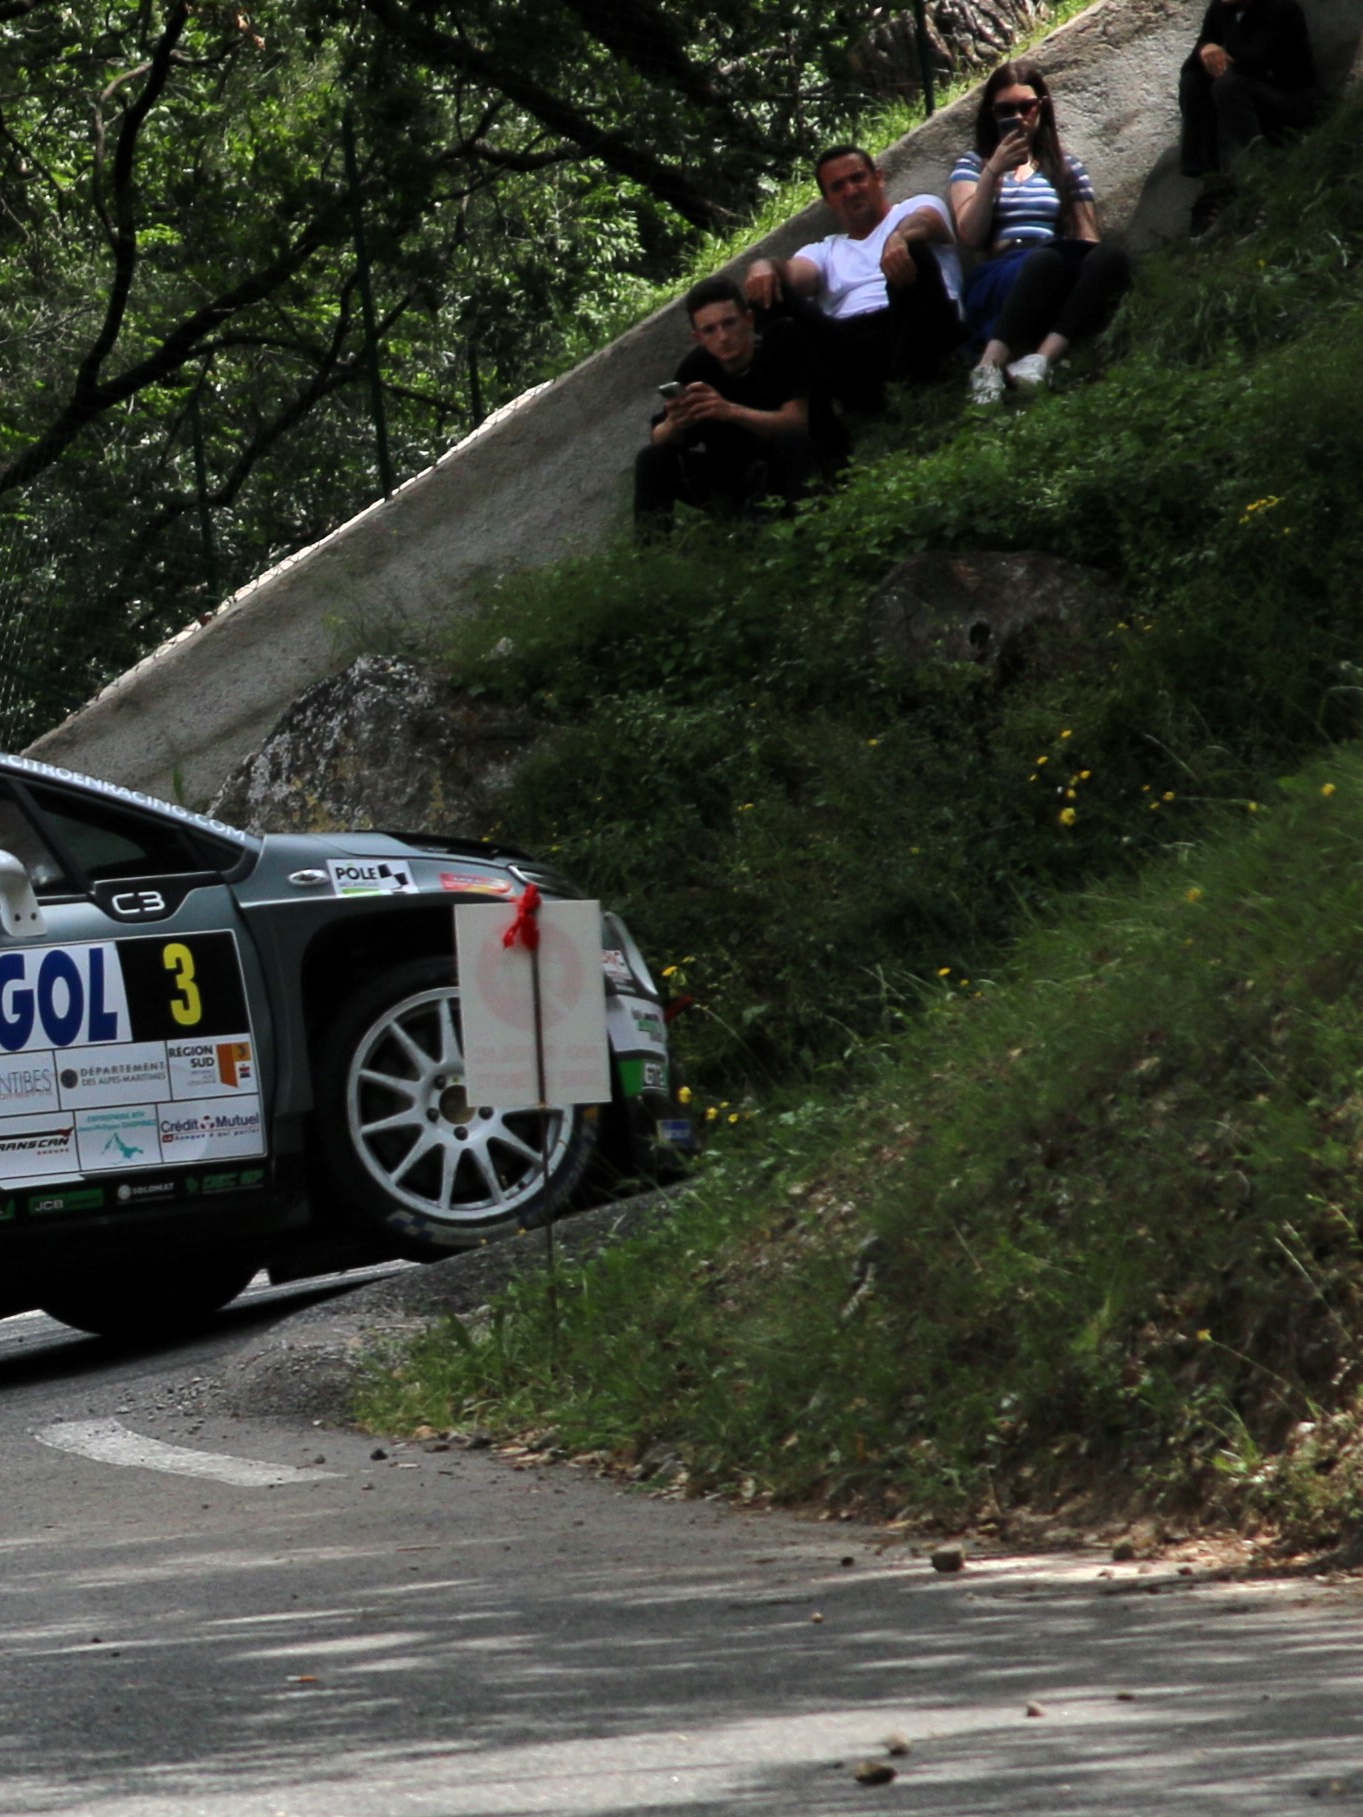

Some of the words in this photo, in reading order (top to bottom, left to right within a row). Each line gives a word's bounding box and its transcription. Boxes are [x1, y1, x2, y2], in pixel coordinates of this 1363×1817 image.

[112, 891, 165, 914] C3
[163, 943, 202, 1025] 3
[191, 1057, 215, 1068] SUD
[161, 1118, 199, 1133] Crédit
[216, 1112, 259, 1128] Mutuel
[35, 1199, 64, 1212] JCB
